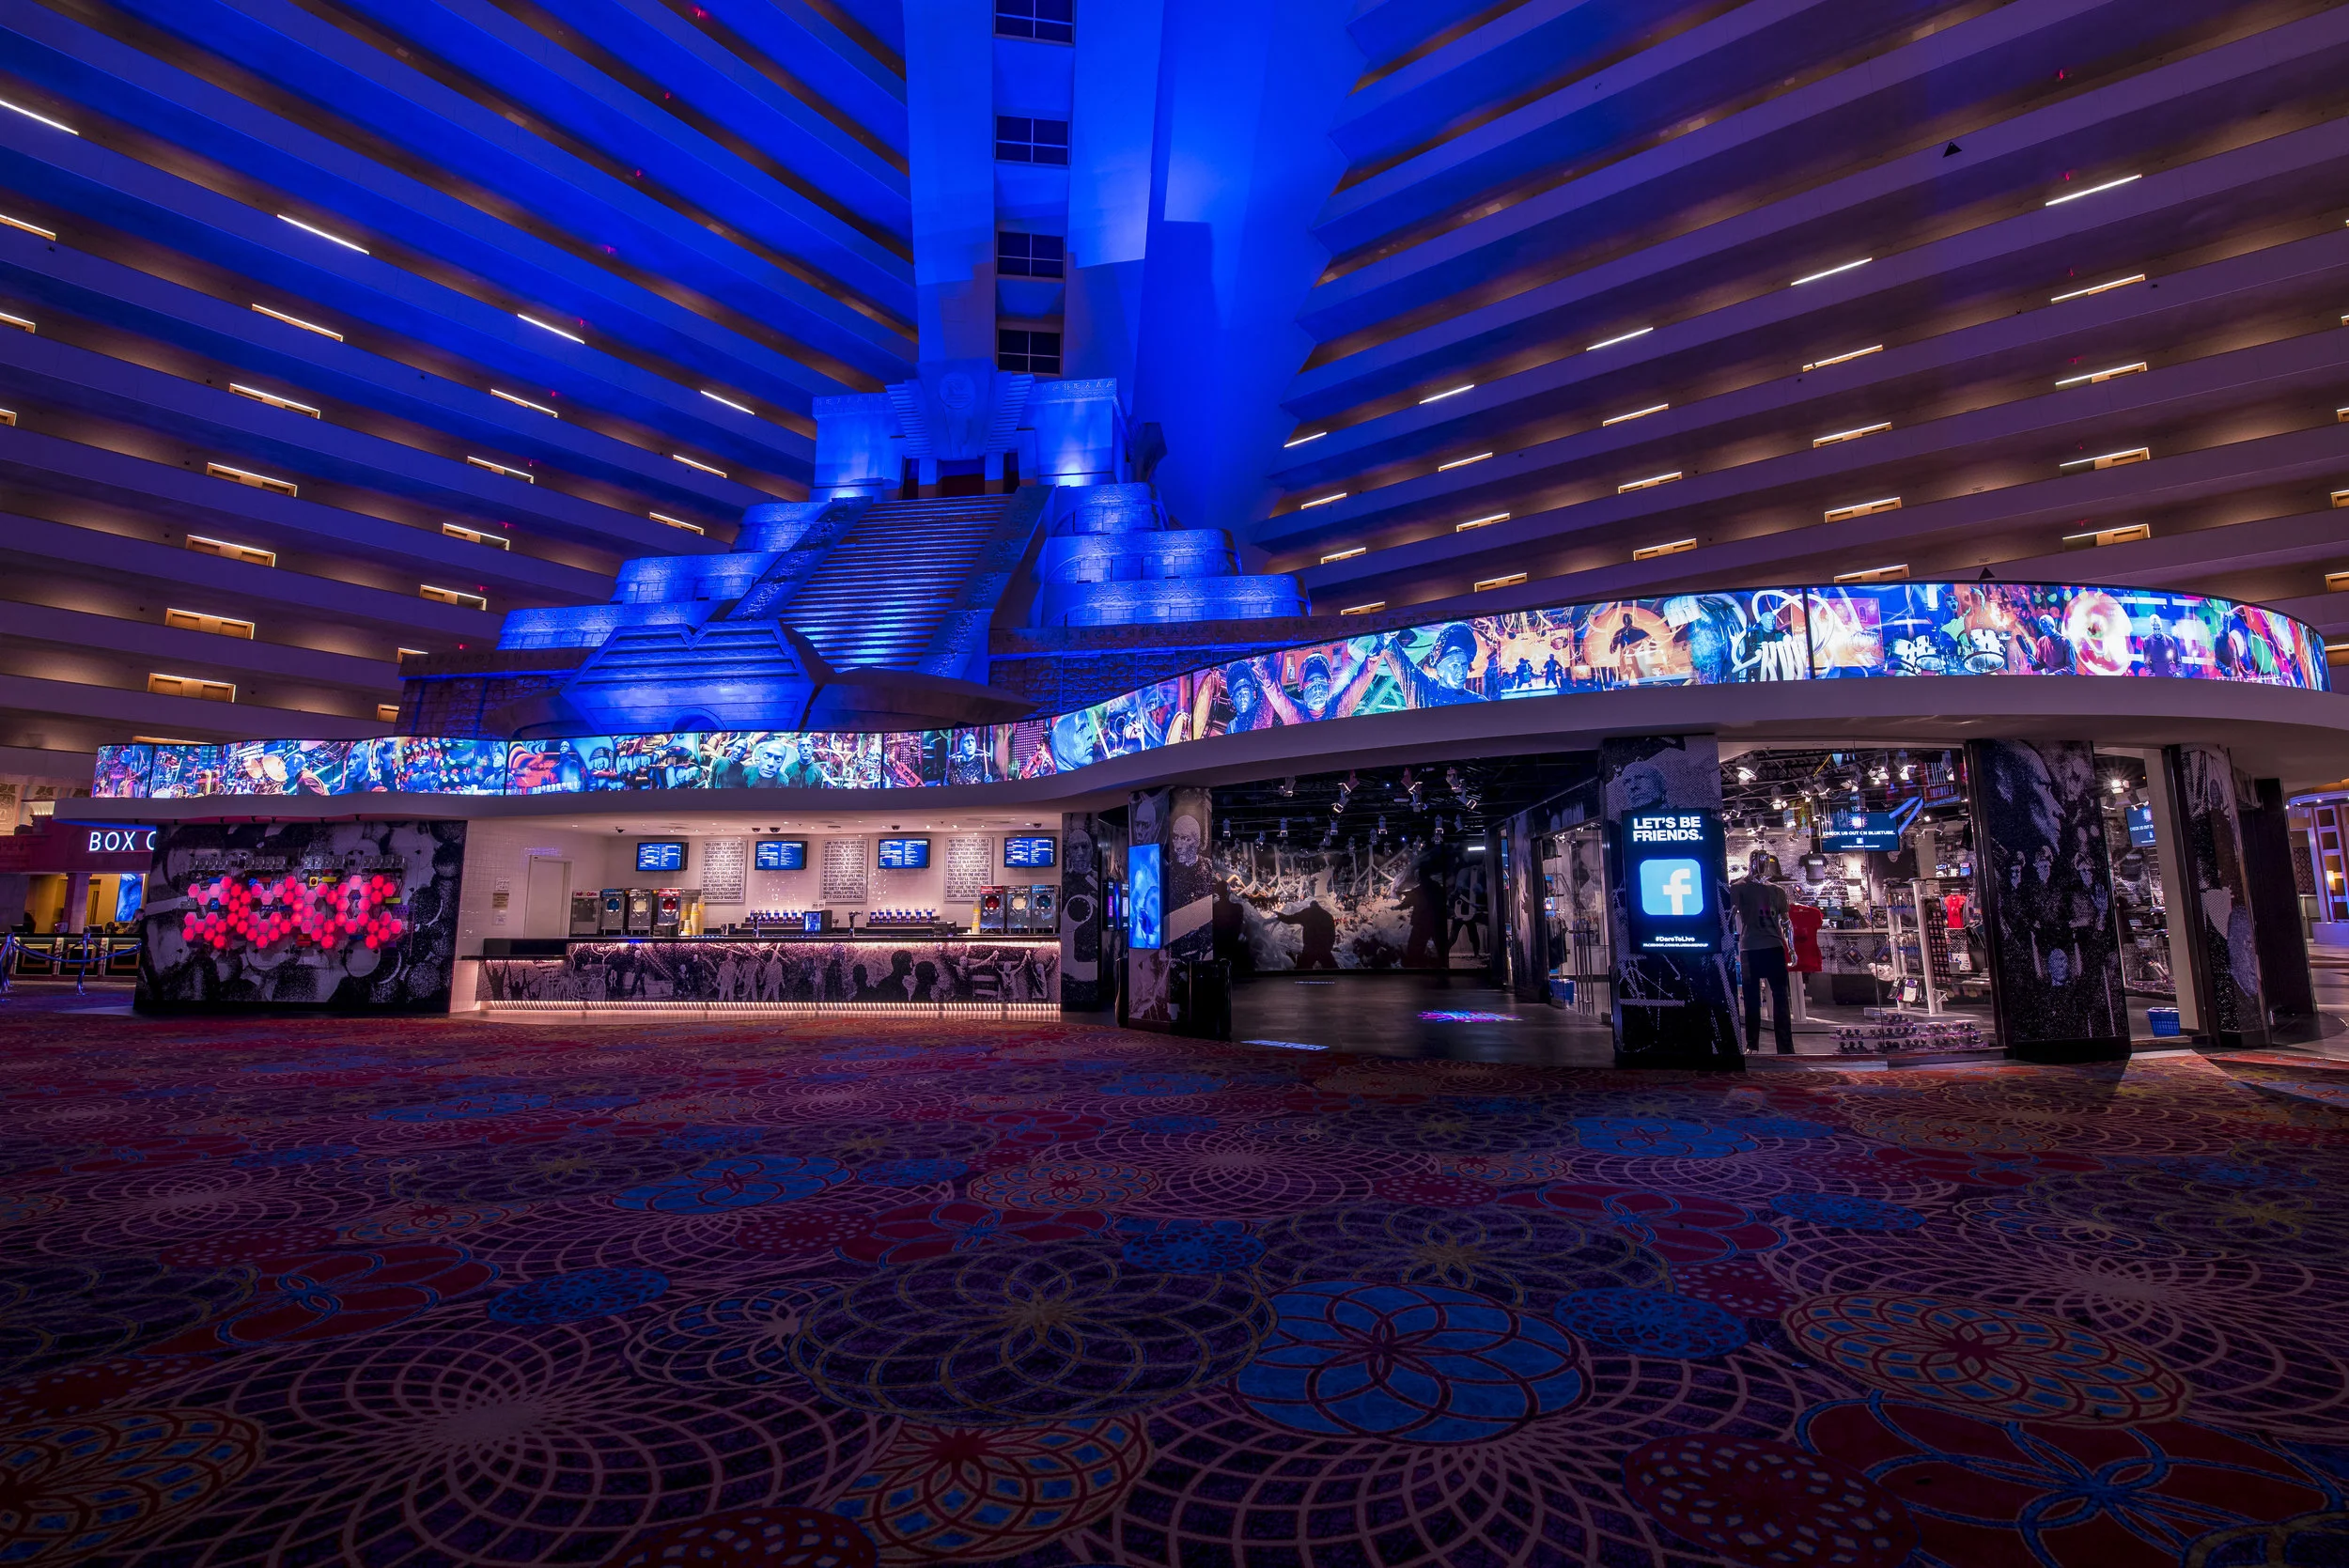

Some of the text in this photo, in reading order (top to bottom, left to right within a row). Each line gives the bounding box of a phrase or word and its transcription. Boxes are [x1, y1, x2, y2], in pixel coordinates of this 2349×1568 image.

[1633, 816, 1702, 830] LET'S BE
[88, 831, 136, 851] BOX
[1633, 829, 1703, 842] FRIENDS.
